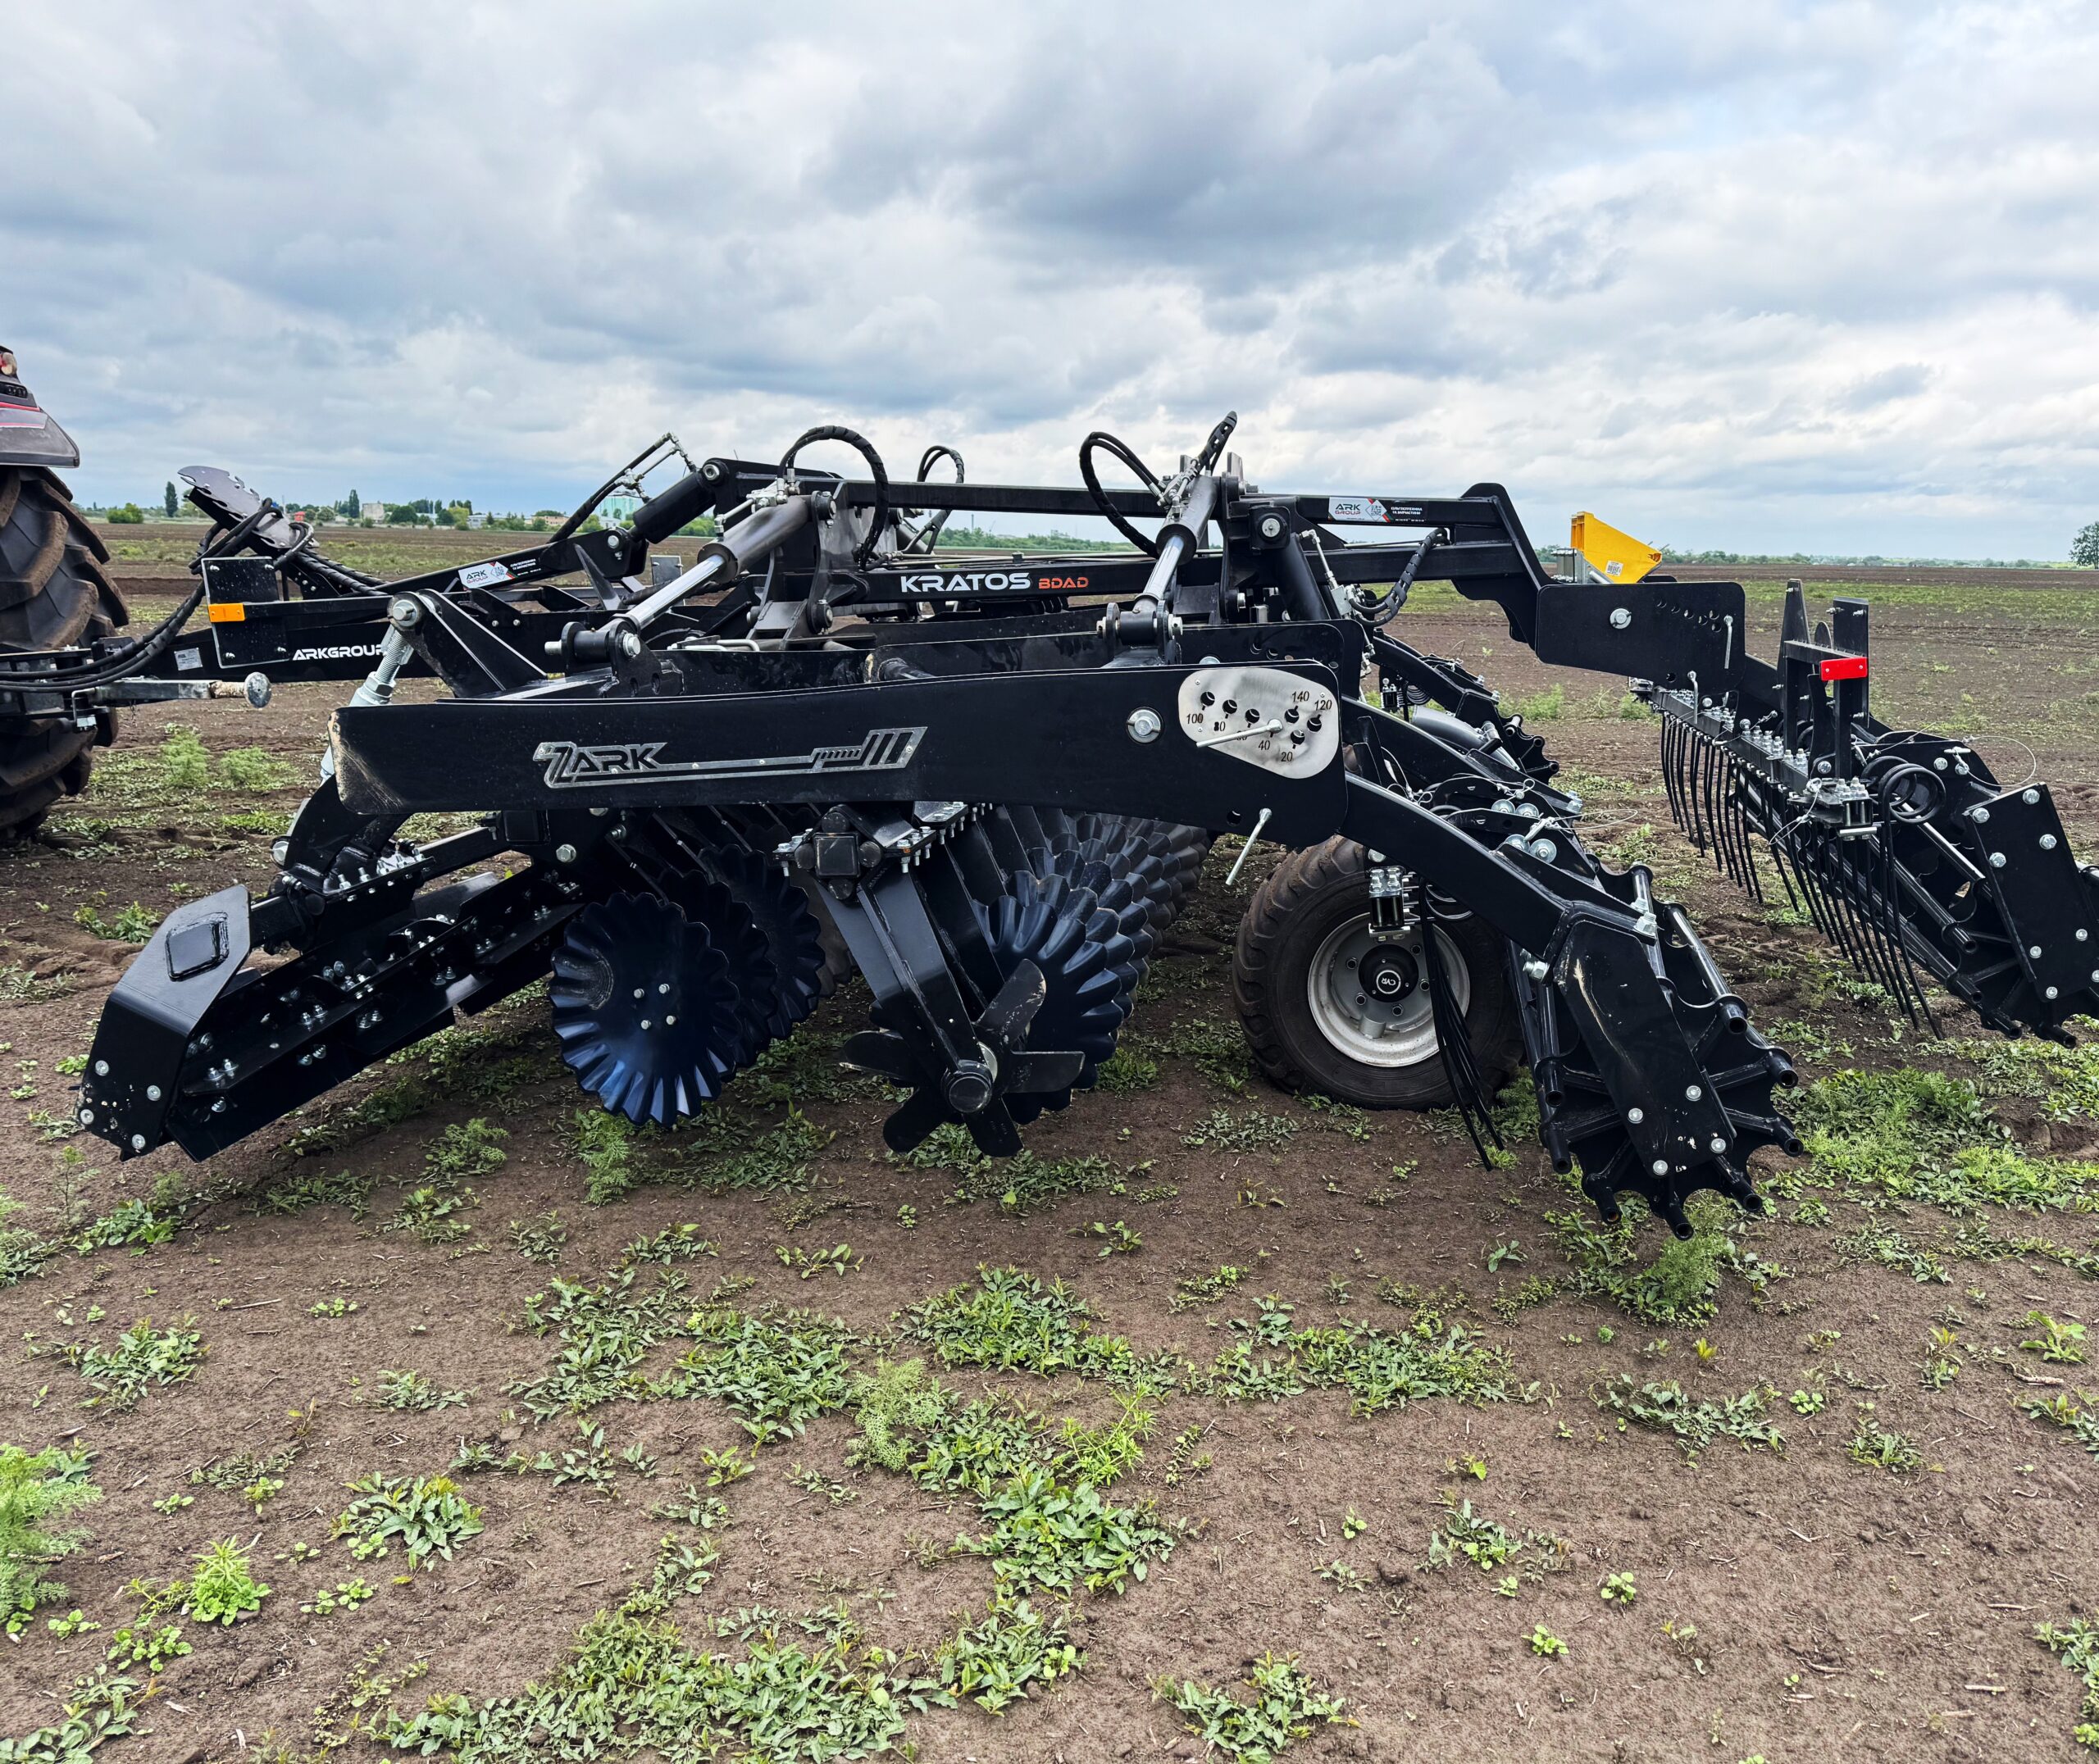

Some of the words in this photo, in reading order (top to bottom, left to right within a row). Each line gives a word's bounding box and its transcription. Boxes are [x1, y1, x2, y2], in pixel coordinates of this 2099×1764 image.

[466, 570, 487, 580] ARK
[900, 573, 1031, 593] KRATOS
[1038, 576, 1089, 589] BDAD
[1291, 691, 1309, 702] 140
[1314, 699, 1332, 712] 120
[1186, 713, 1204, 725] 100
[1213, 721, 1226, 732] 80
[1258, 739, 1270, 751] 40
[1281, 751, 1293, 762] 20
